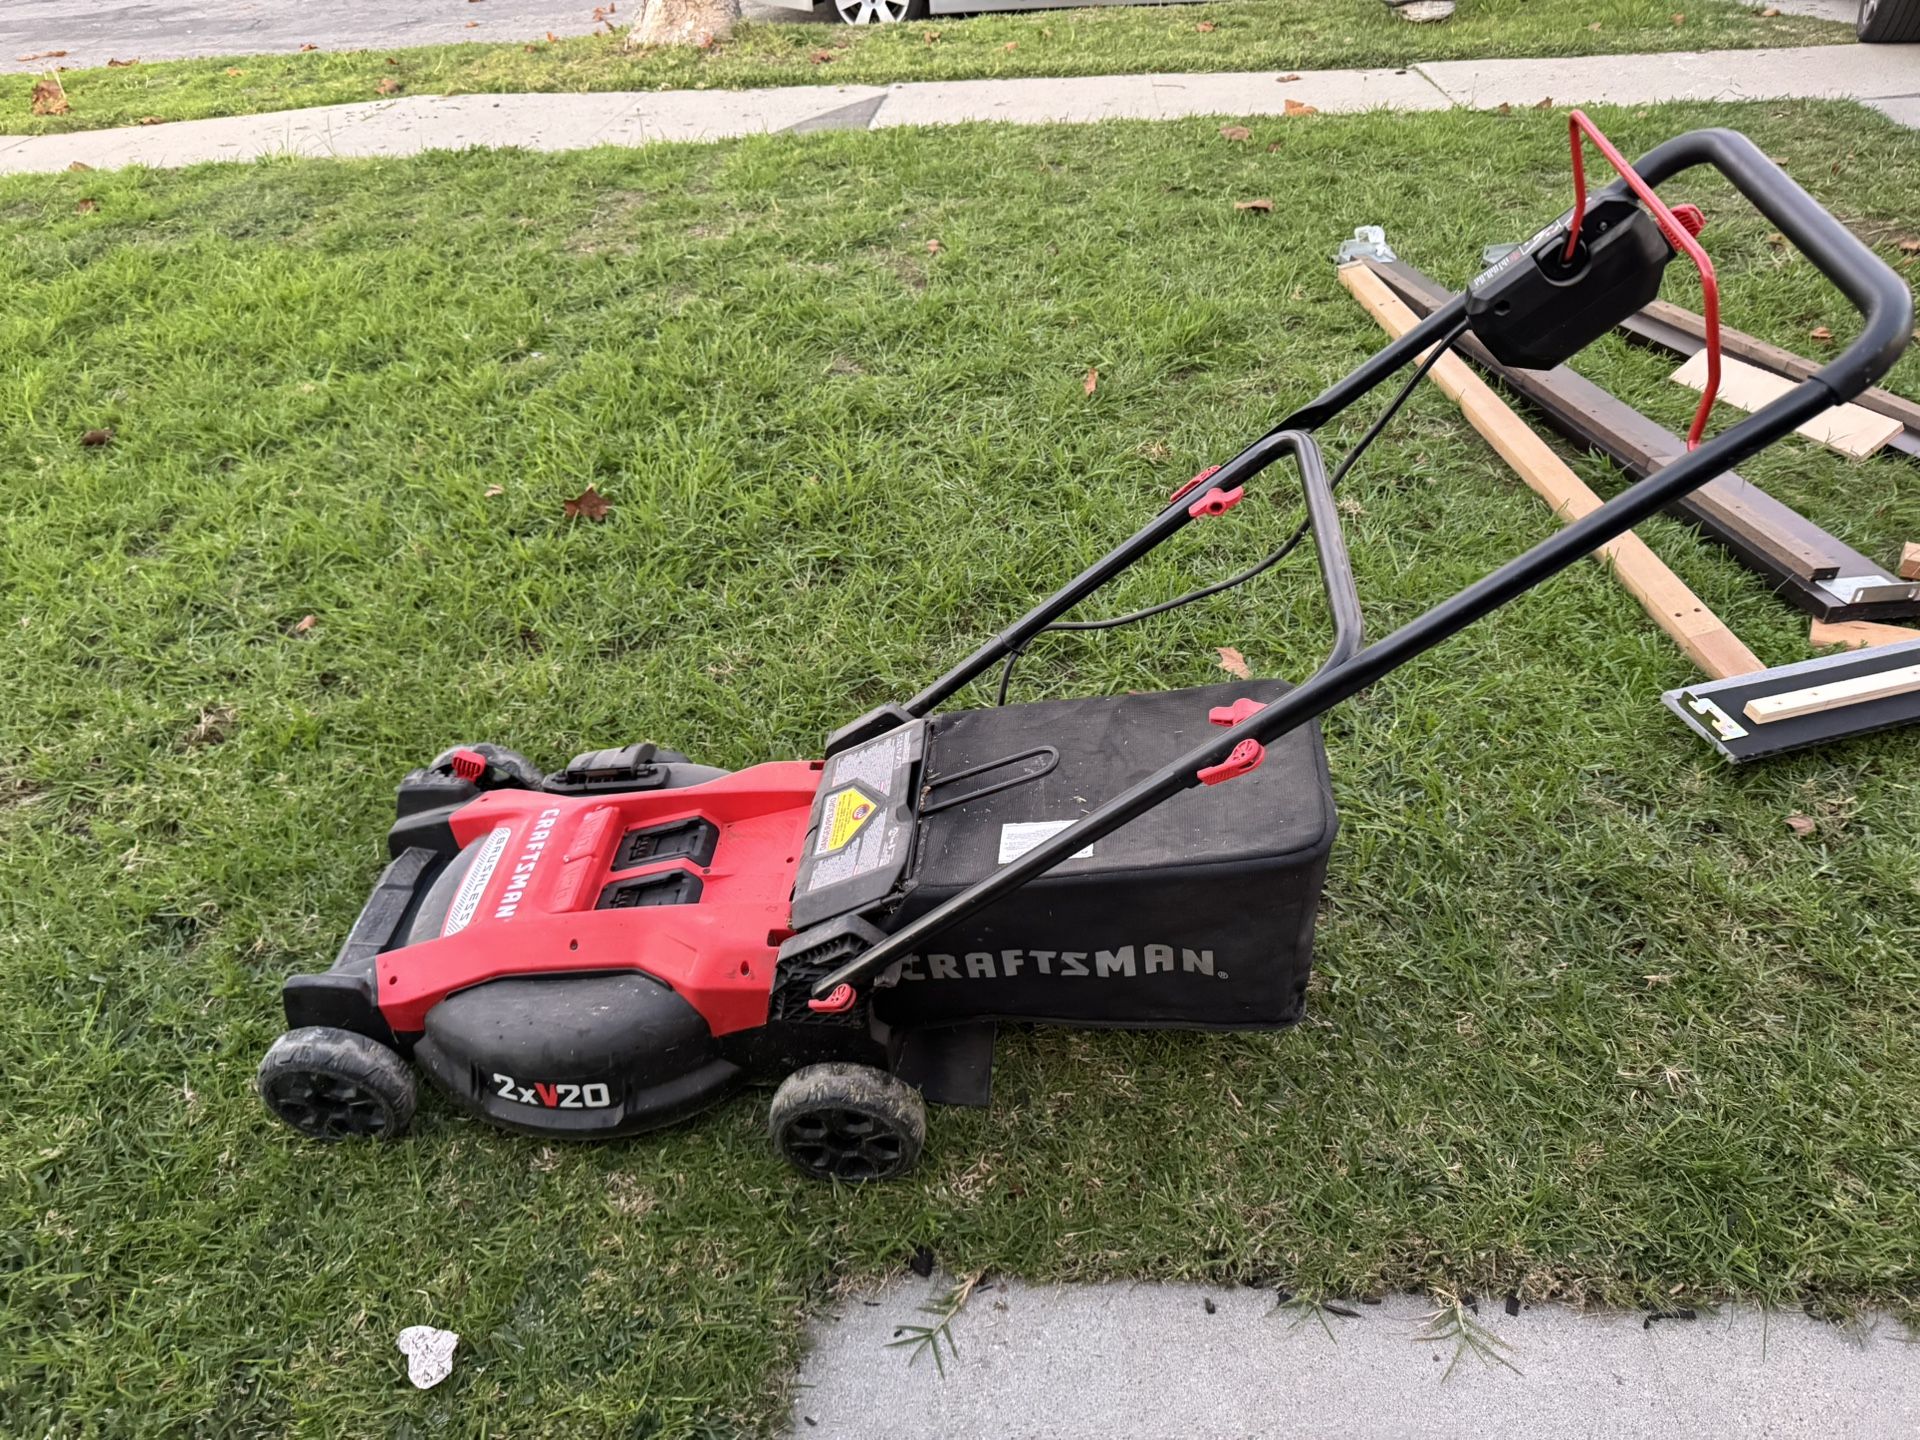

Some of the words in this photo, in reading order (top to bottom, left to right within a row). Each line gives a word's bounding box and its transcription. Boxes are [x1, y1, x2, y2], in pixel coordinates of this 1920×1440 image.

[459, 836, 507, 922] BRUSHLESS
[494, 807, 561, 919] CRAFTSMAN
[492, 1072, 611, 1109] 2xV20
